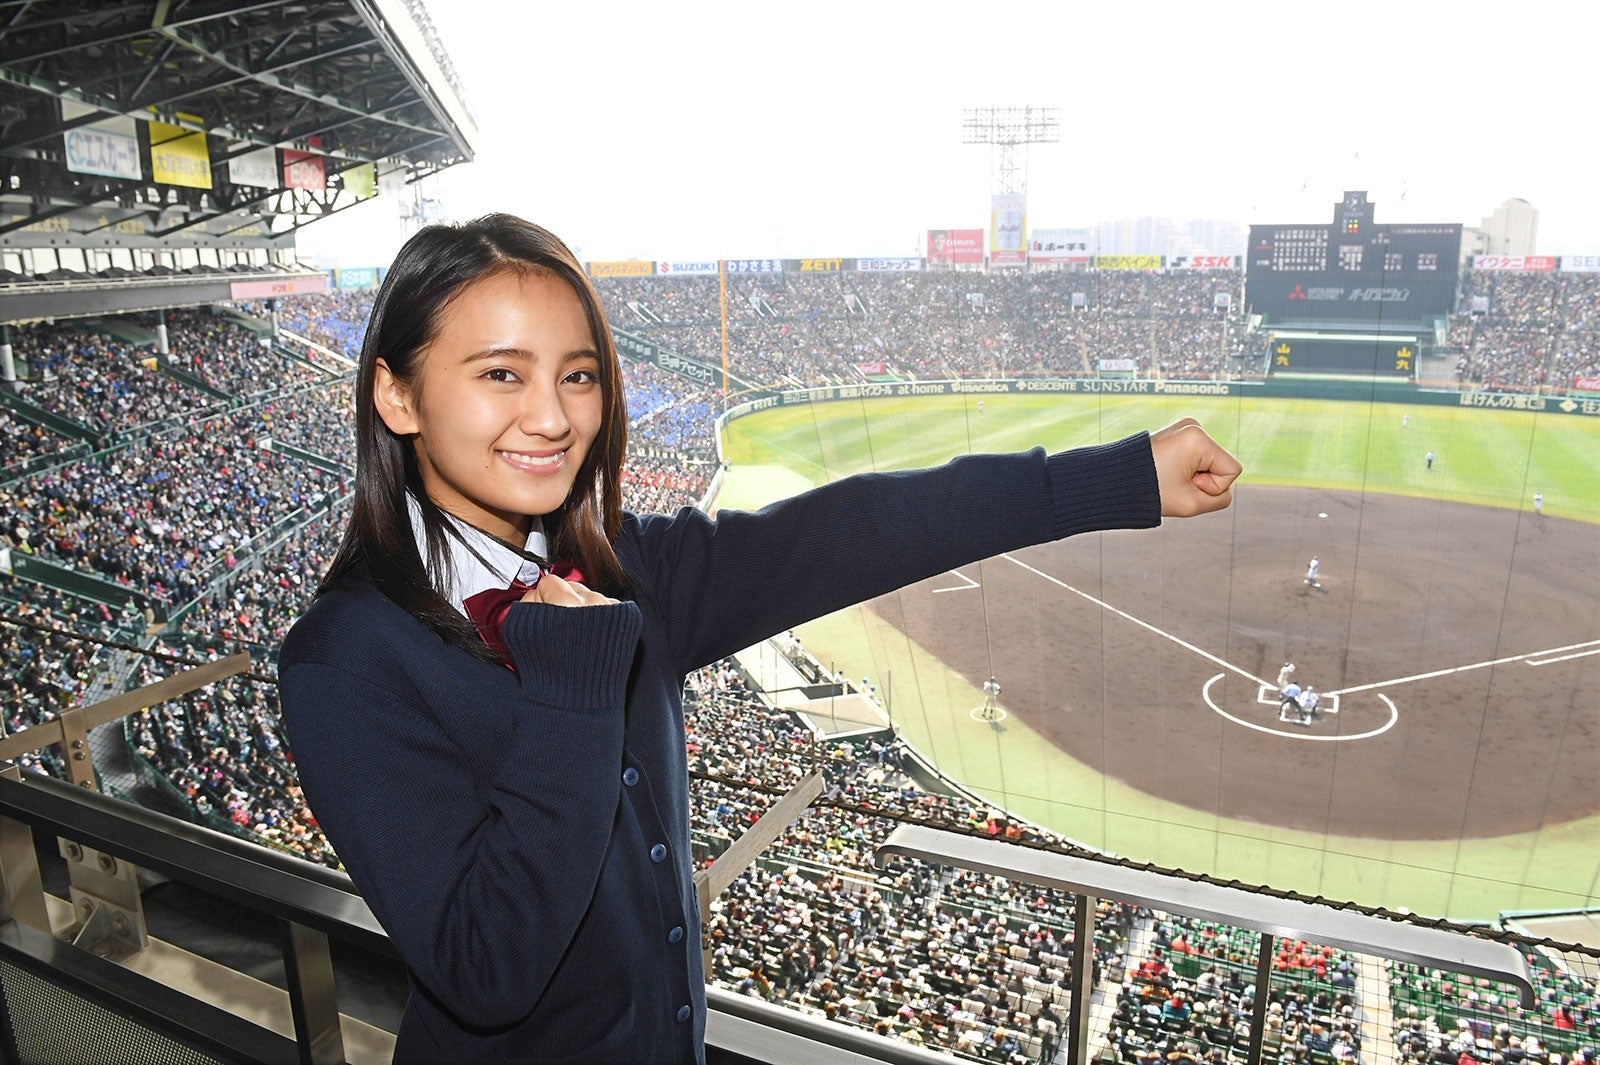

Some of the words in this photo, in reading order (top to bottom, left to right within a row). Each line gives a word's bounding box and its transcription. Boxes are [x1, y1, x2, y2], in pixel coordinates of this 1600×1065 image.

[289, 159, 319, 187] ECC
[672, 262, 716, 272] SUZUKI
[727, 259, 783, 272] わかさ生活
[800, 258, 843, 271] ZETT
[1096, 256, 1160, 268] 関西ペイント
[1191, 256, 1232, 268] SSK
[1477, 256, 1523, 268] イワタニ
[897, 385, 910, 395] at
[912, 383, 945, 394] home
[1027, 381, 1077, 391] DESCENTE
[1083, 381, 1148, 392] SUNSTAR
[1154, 381, 1230, 395] Panasonic
